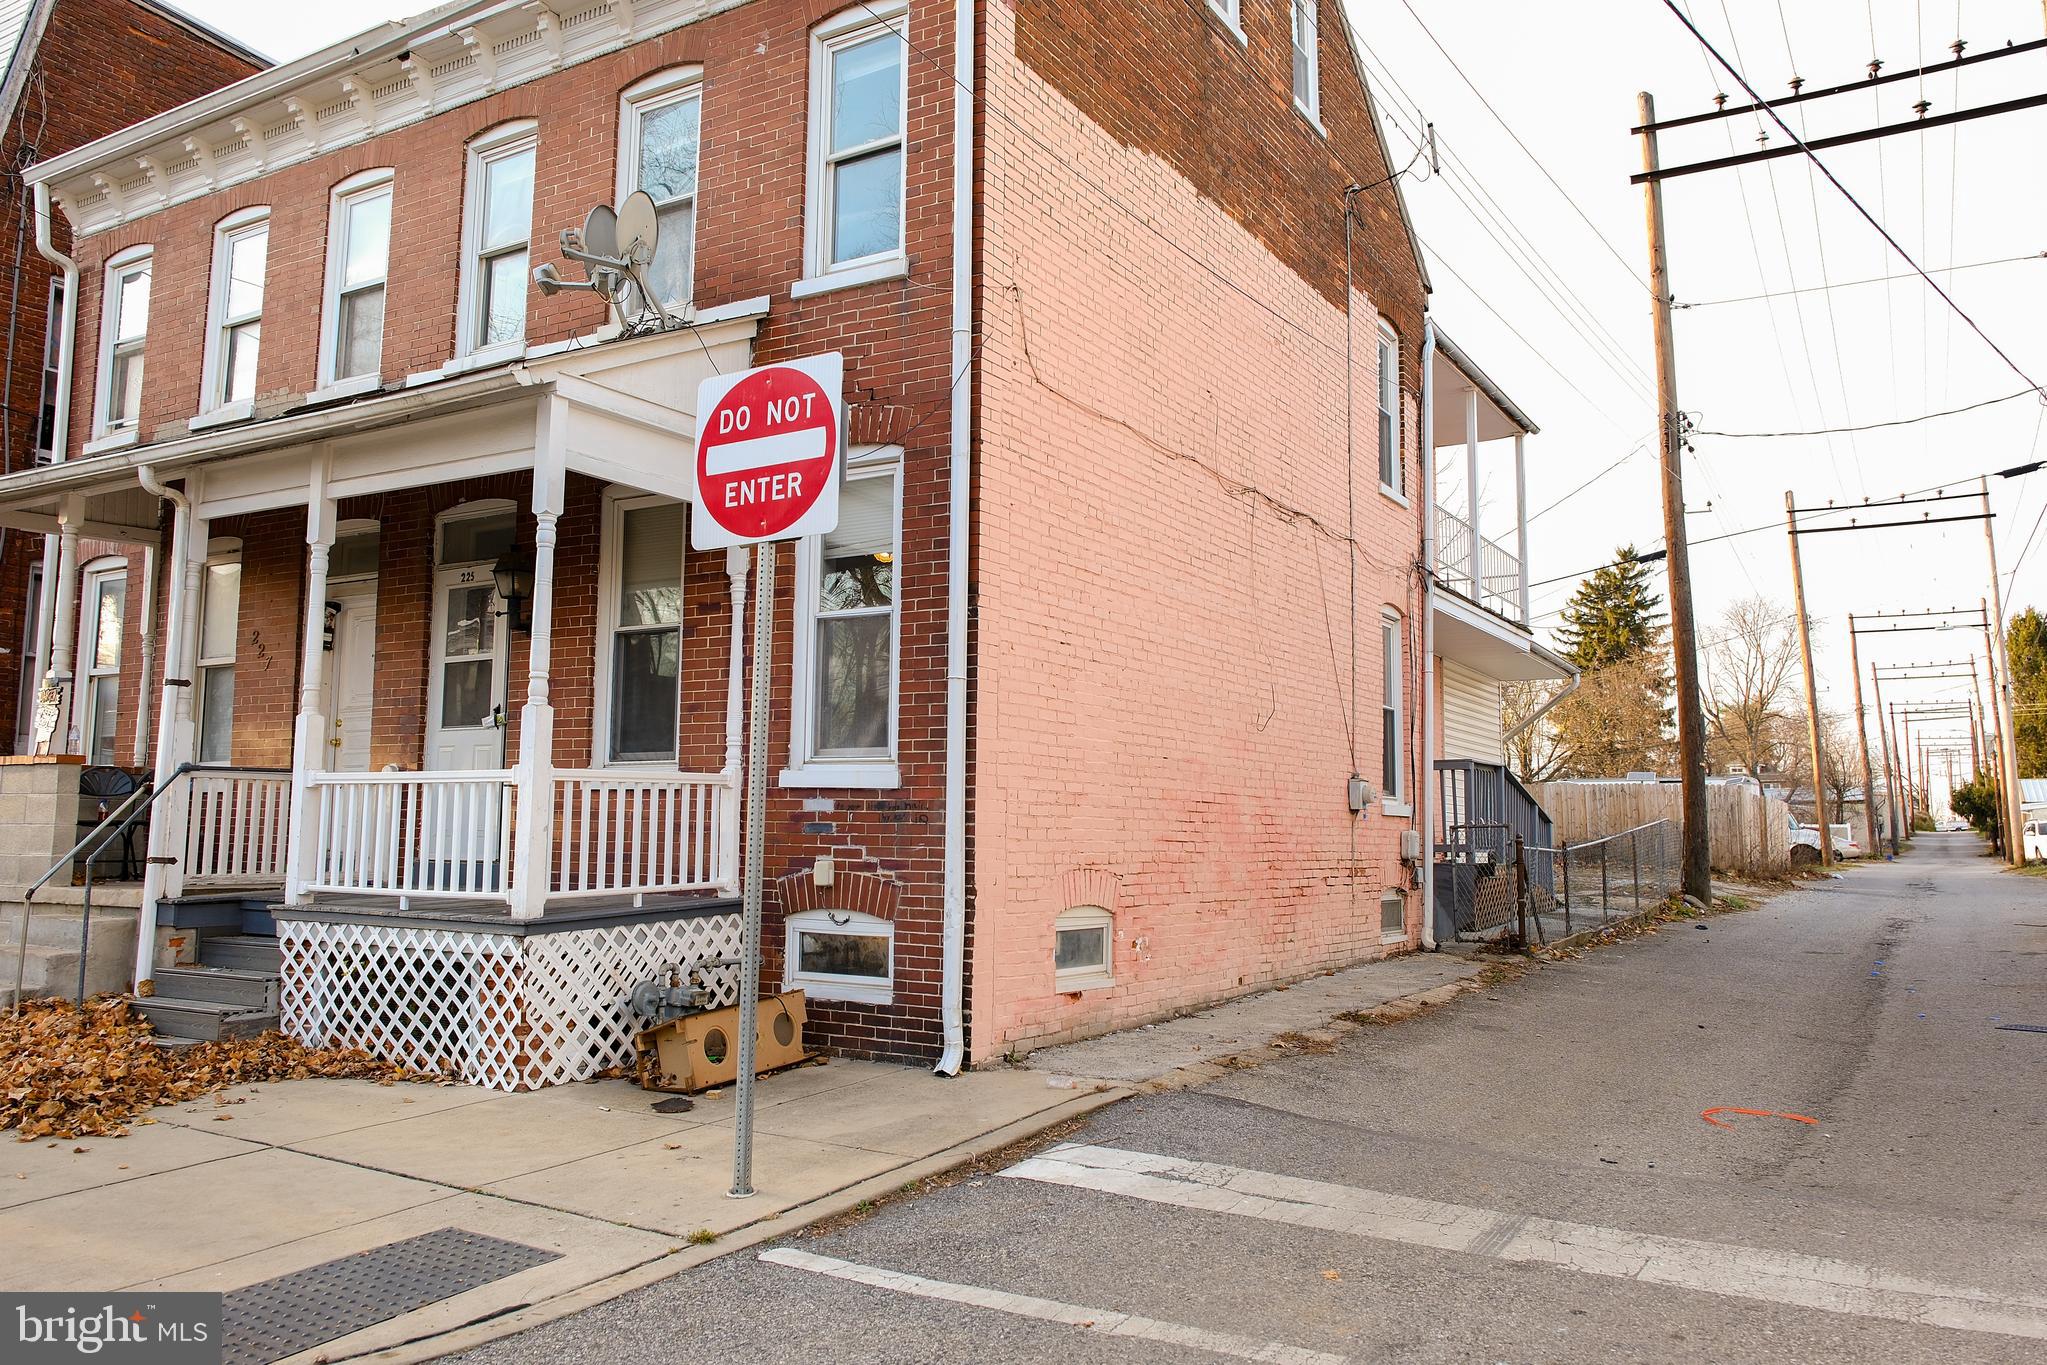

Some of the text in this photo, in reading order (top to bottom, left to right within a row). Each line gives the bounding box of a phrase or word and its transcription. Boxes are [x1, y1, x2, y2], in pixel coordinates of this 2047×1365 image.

[719, 392, 816, 434] DO NOT
[725, 472, 802, 508] ENTER
[461, 571, 475, 582] 225
[251, 630, 273, 671] 227
